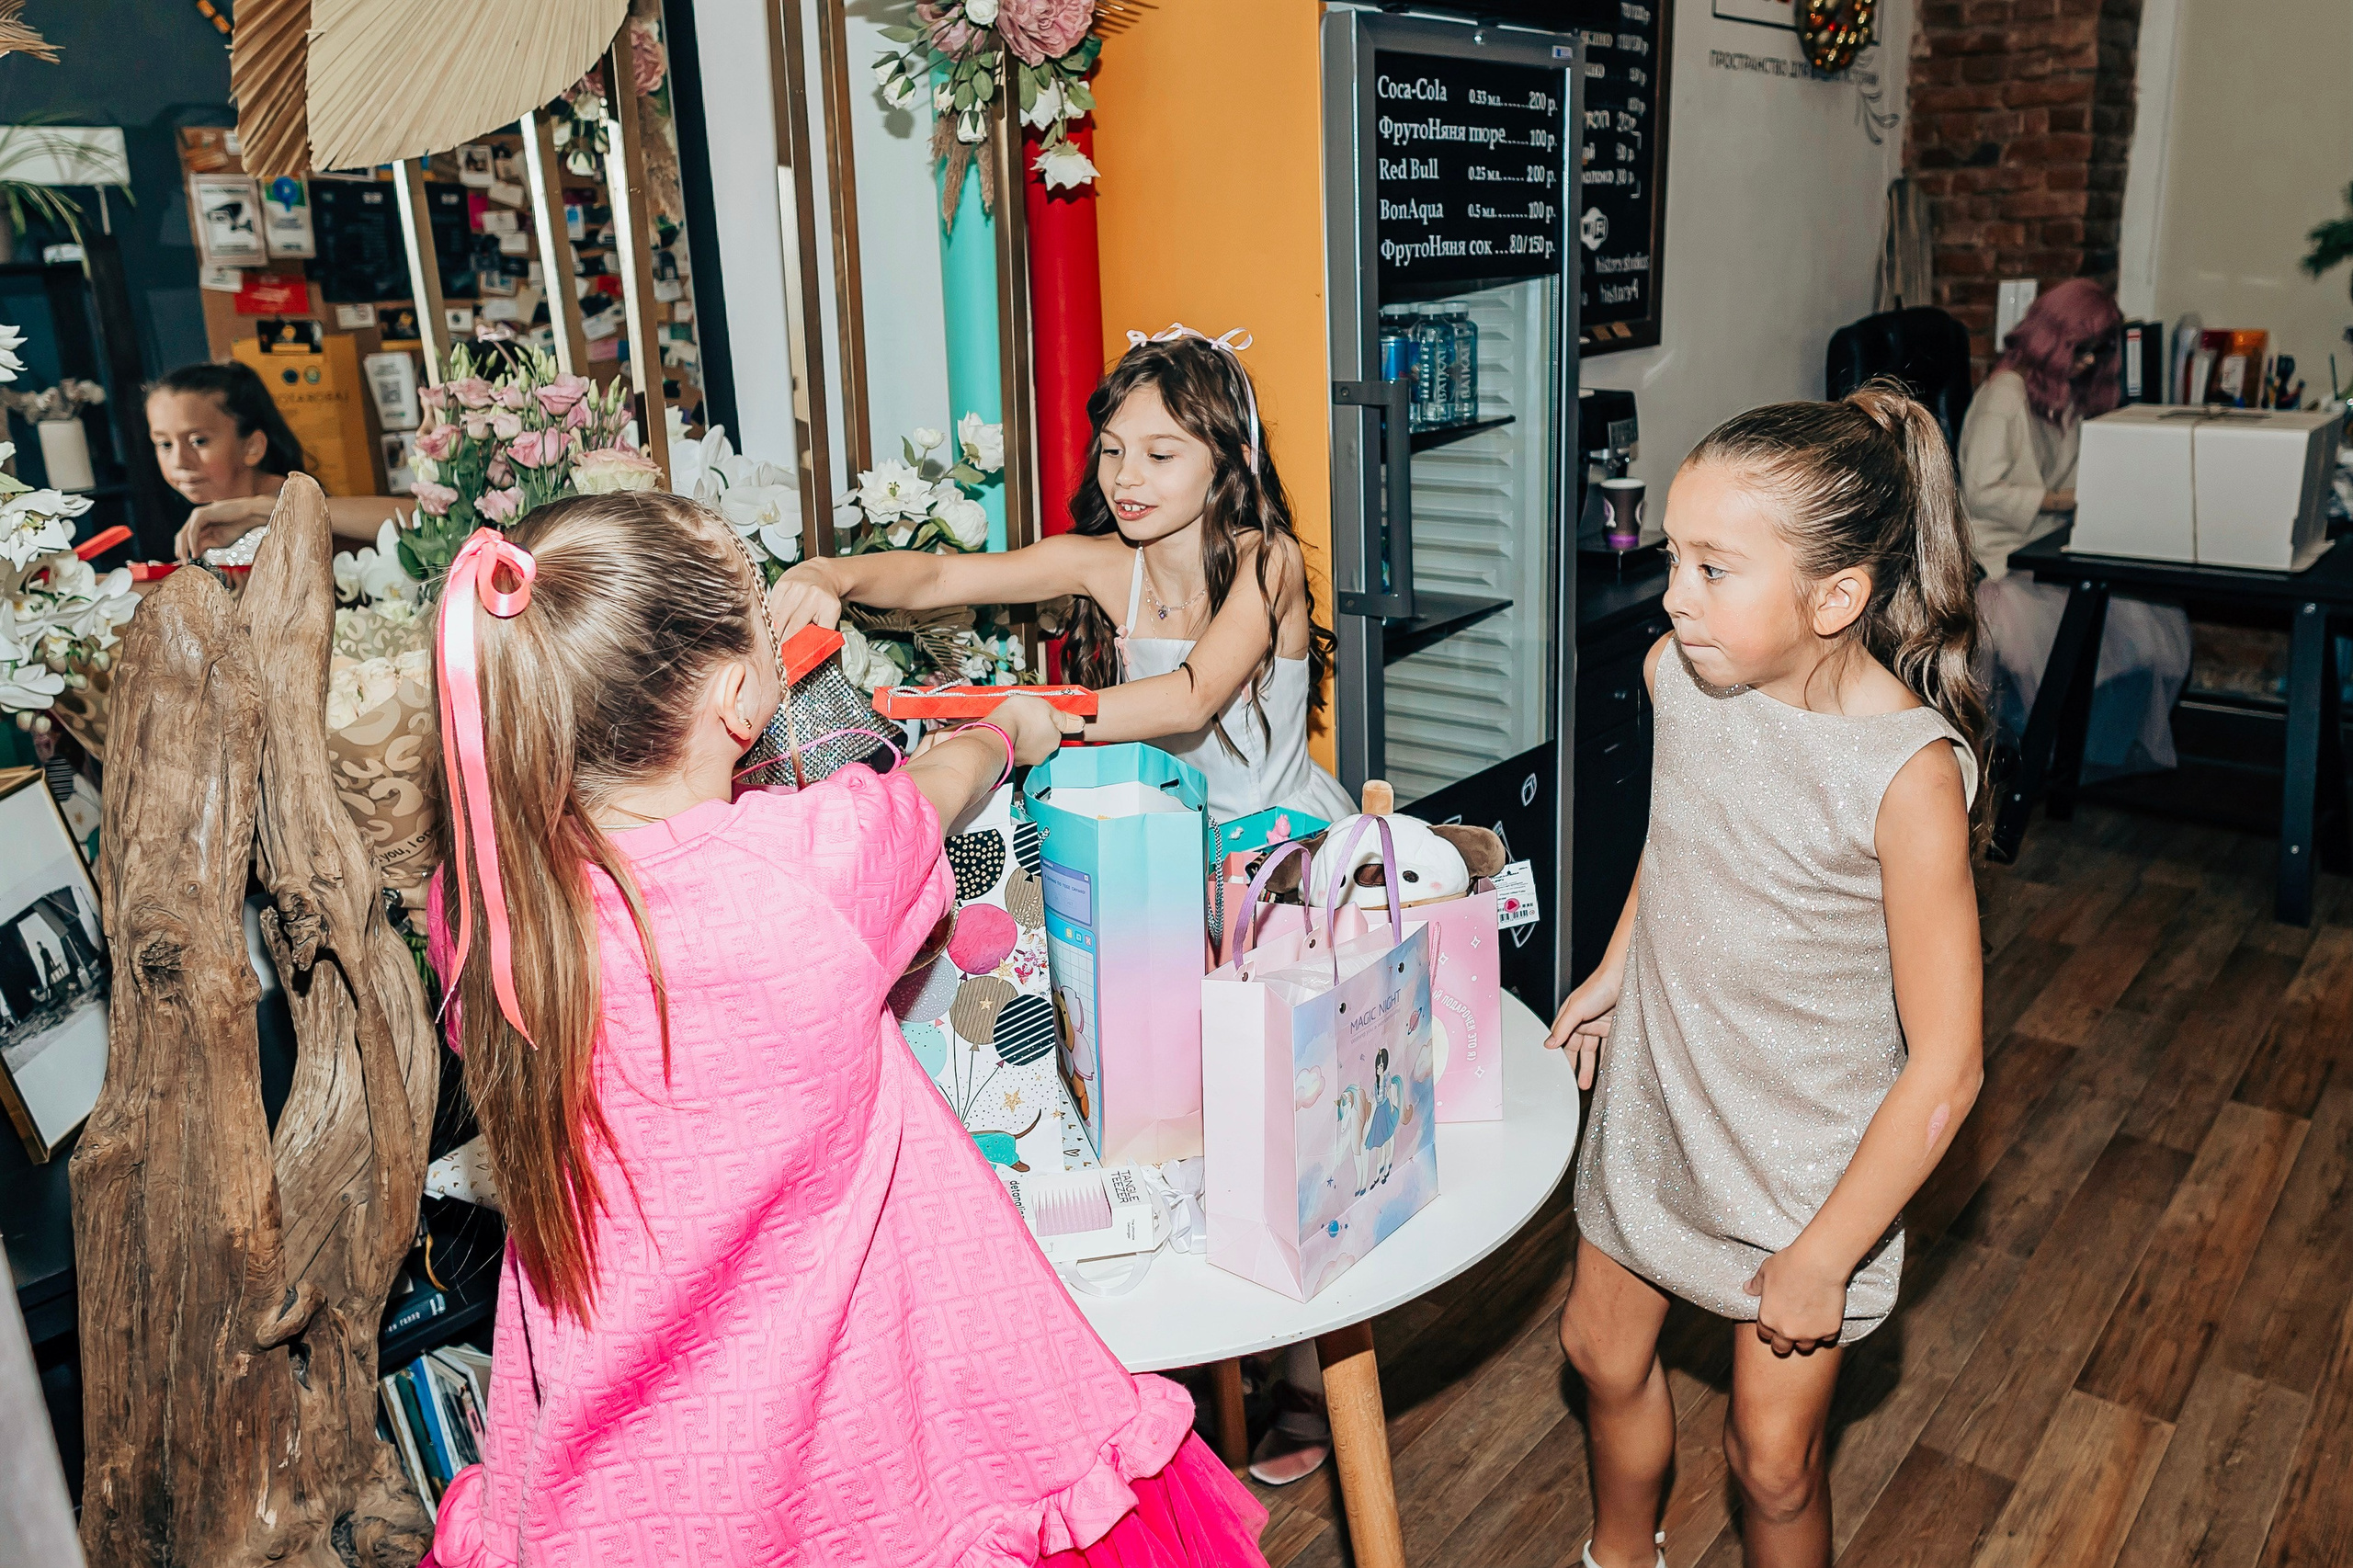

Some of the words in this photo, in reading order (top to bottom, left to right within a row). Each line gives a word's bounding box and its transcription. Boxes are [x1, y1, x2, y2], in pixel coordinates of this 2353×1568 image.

[1378, 75, 1448, 102] Coca-Cola
[1379, 116, 1466, 146] ФрутоНяня
[1379, 158, 1408, 180] Red
[1411, 158, 1439, 180] Bull
[1380, 198, 1444, 225] BonAqua
[1381, 234, 1466, 267] ФрутоНяня
[1469, 240, 1493, 256] сок
[1350, 1006, 1377, 1035] MAGIC
[1379, 988, 1401, 1017] NIGHT
[1440, 994, 1476, 1032] ПОДАРОЧЕК
[1467, 1032, 1477, 1049] ЭТО
[1110, 1170, 1129, 1204] TEEZER
[1120, 1169, 1140, 1202] TANGLE
